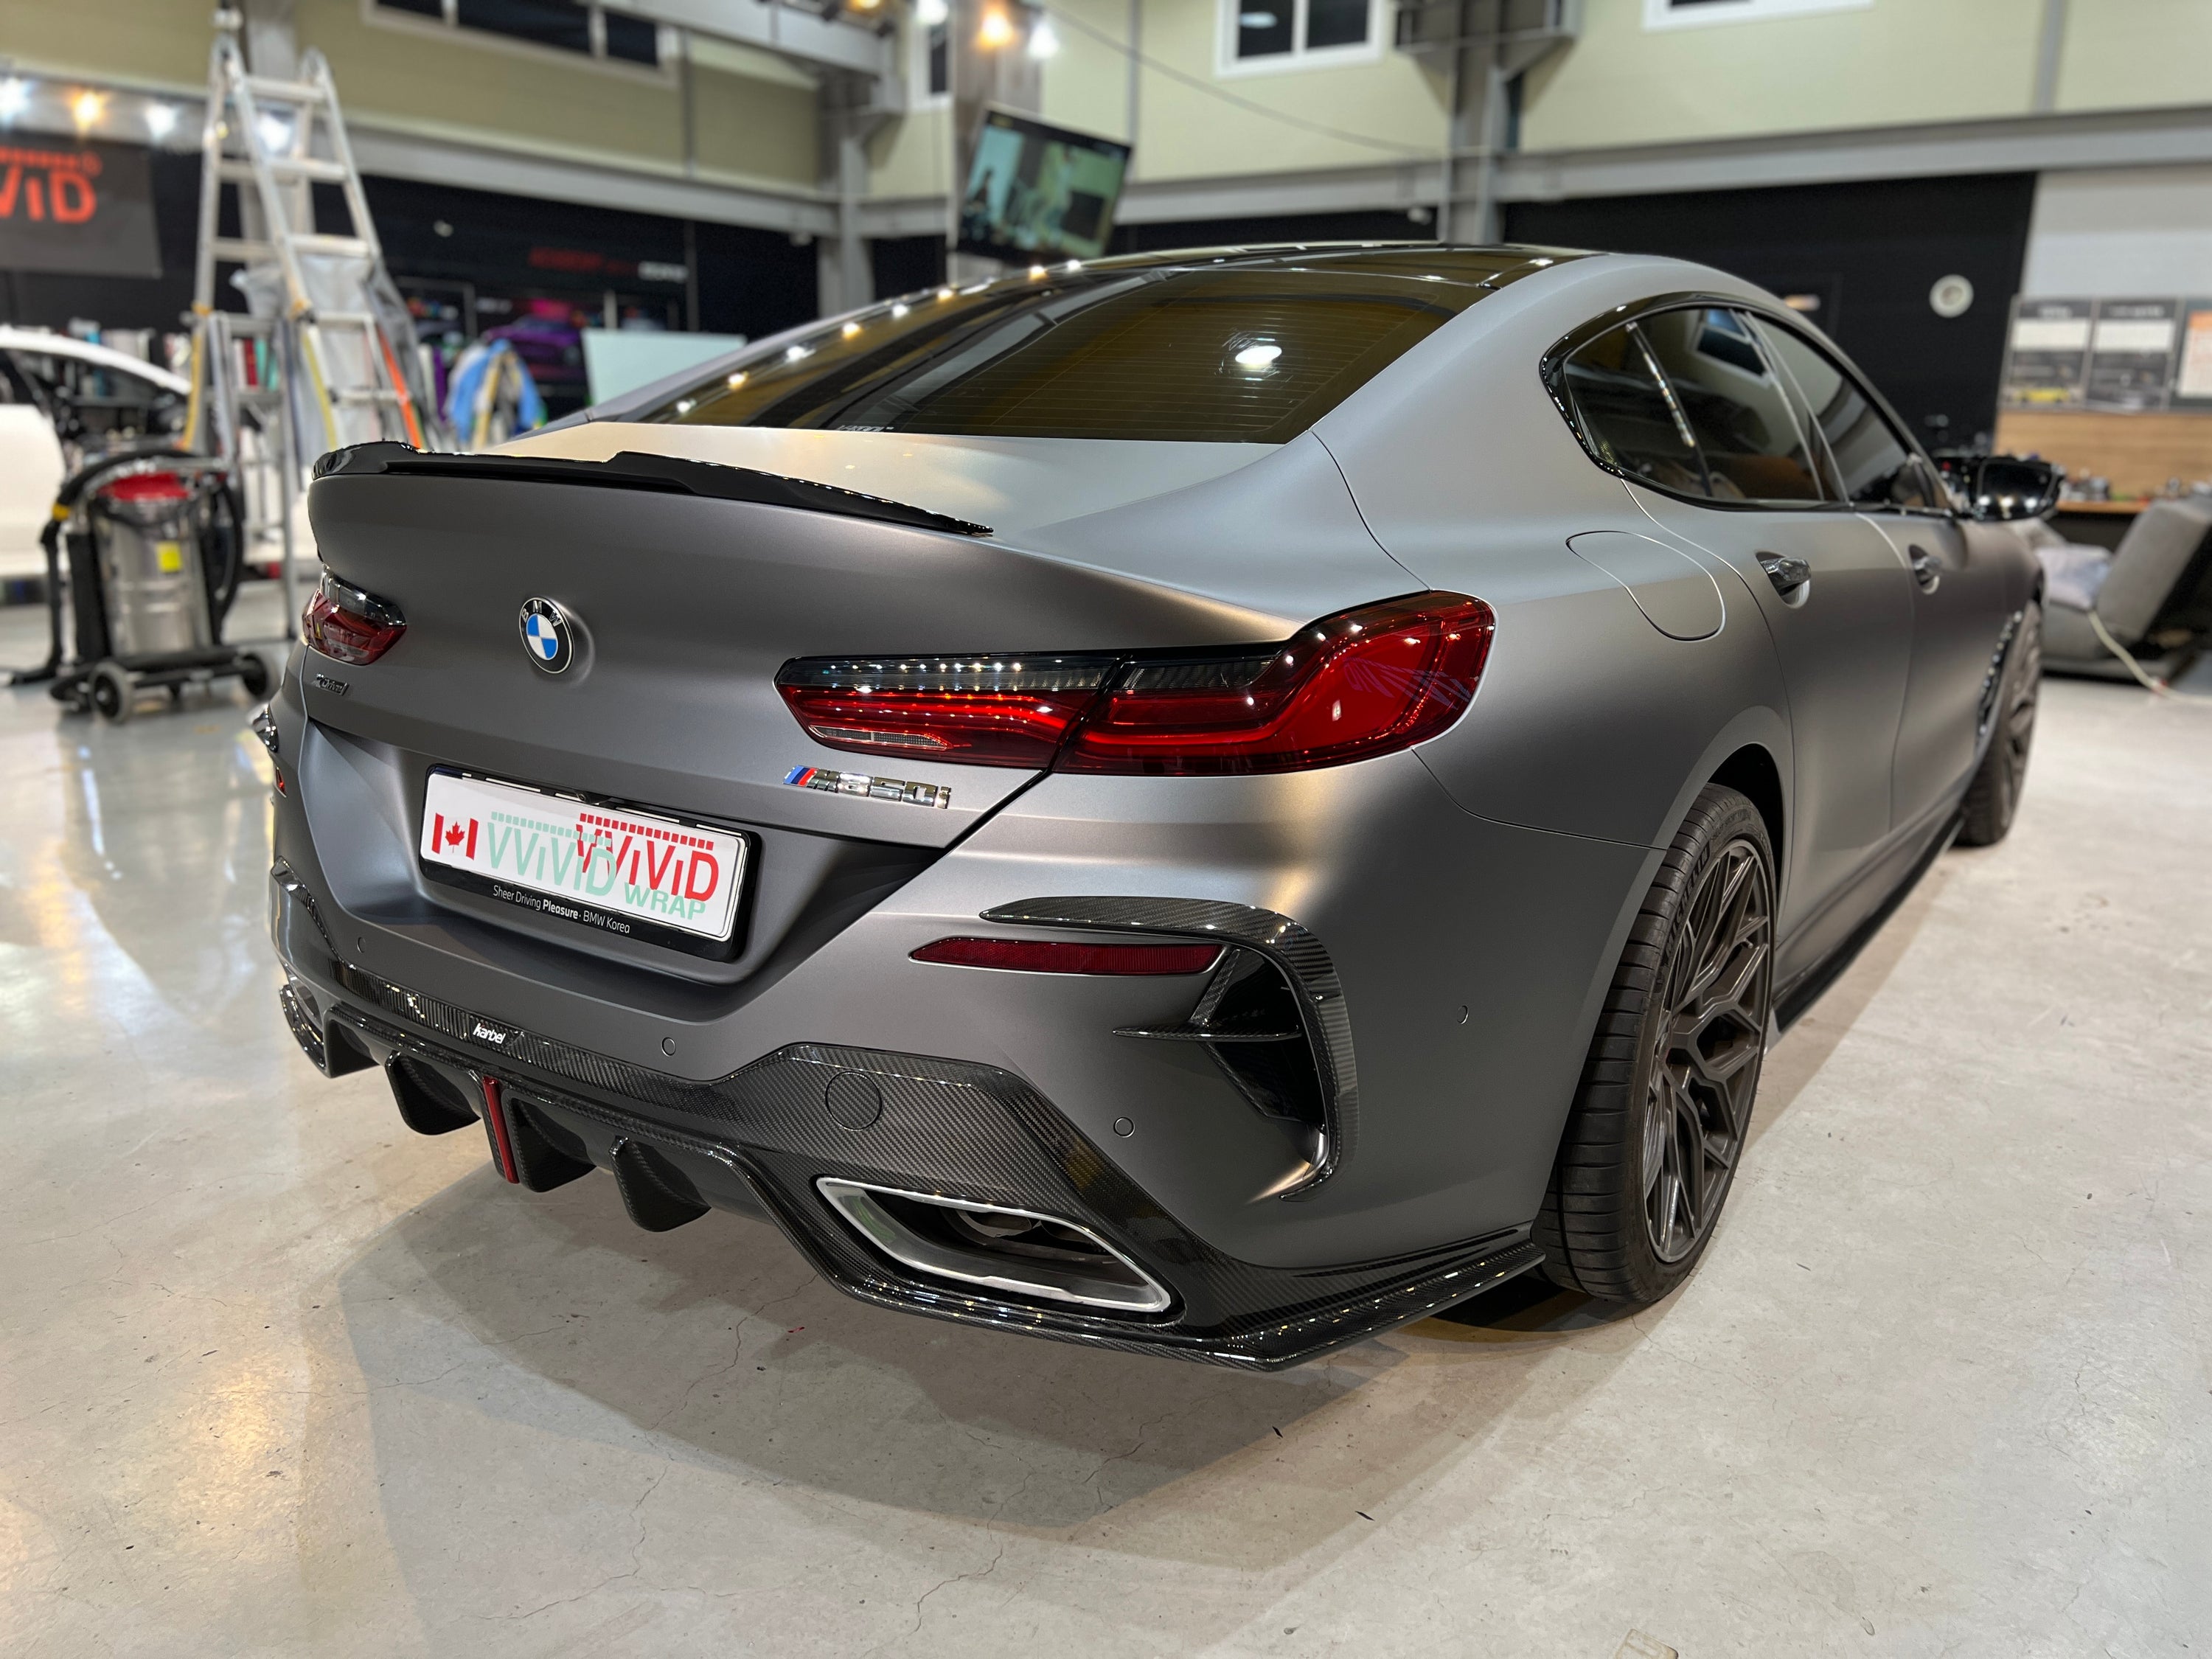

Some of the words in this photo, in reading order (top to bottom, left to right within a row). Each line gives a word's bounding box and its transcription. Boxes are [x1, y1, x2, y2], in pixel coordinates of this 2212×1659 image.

[521, 599, 563, 627] BMW
[493, 885, 515, 901] Sheer
[515, 891, 542, 911] Driving
[582, 910, 606, 927] BMW
[606, 917, 630, 934] Korea
[625, 882, 706, 920] WRAP
